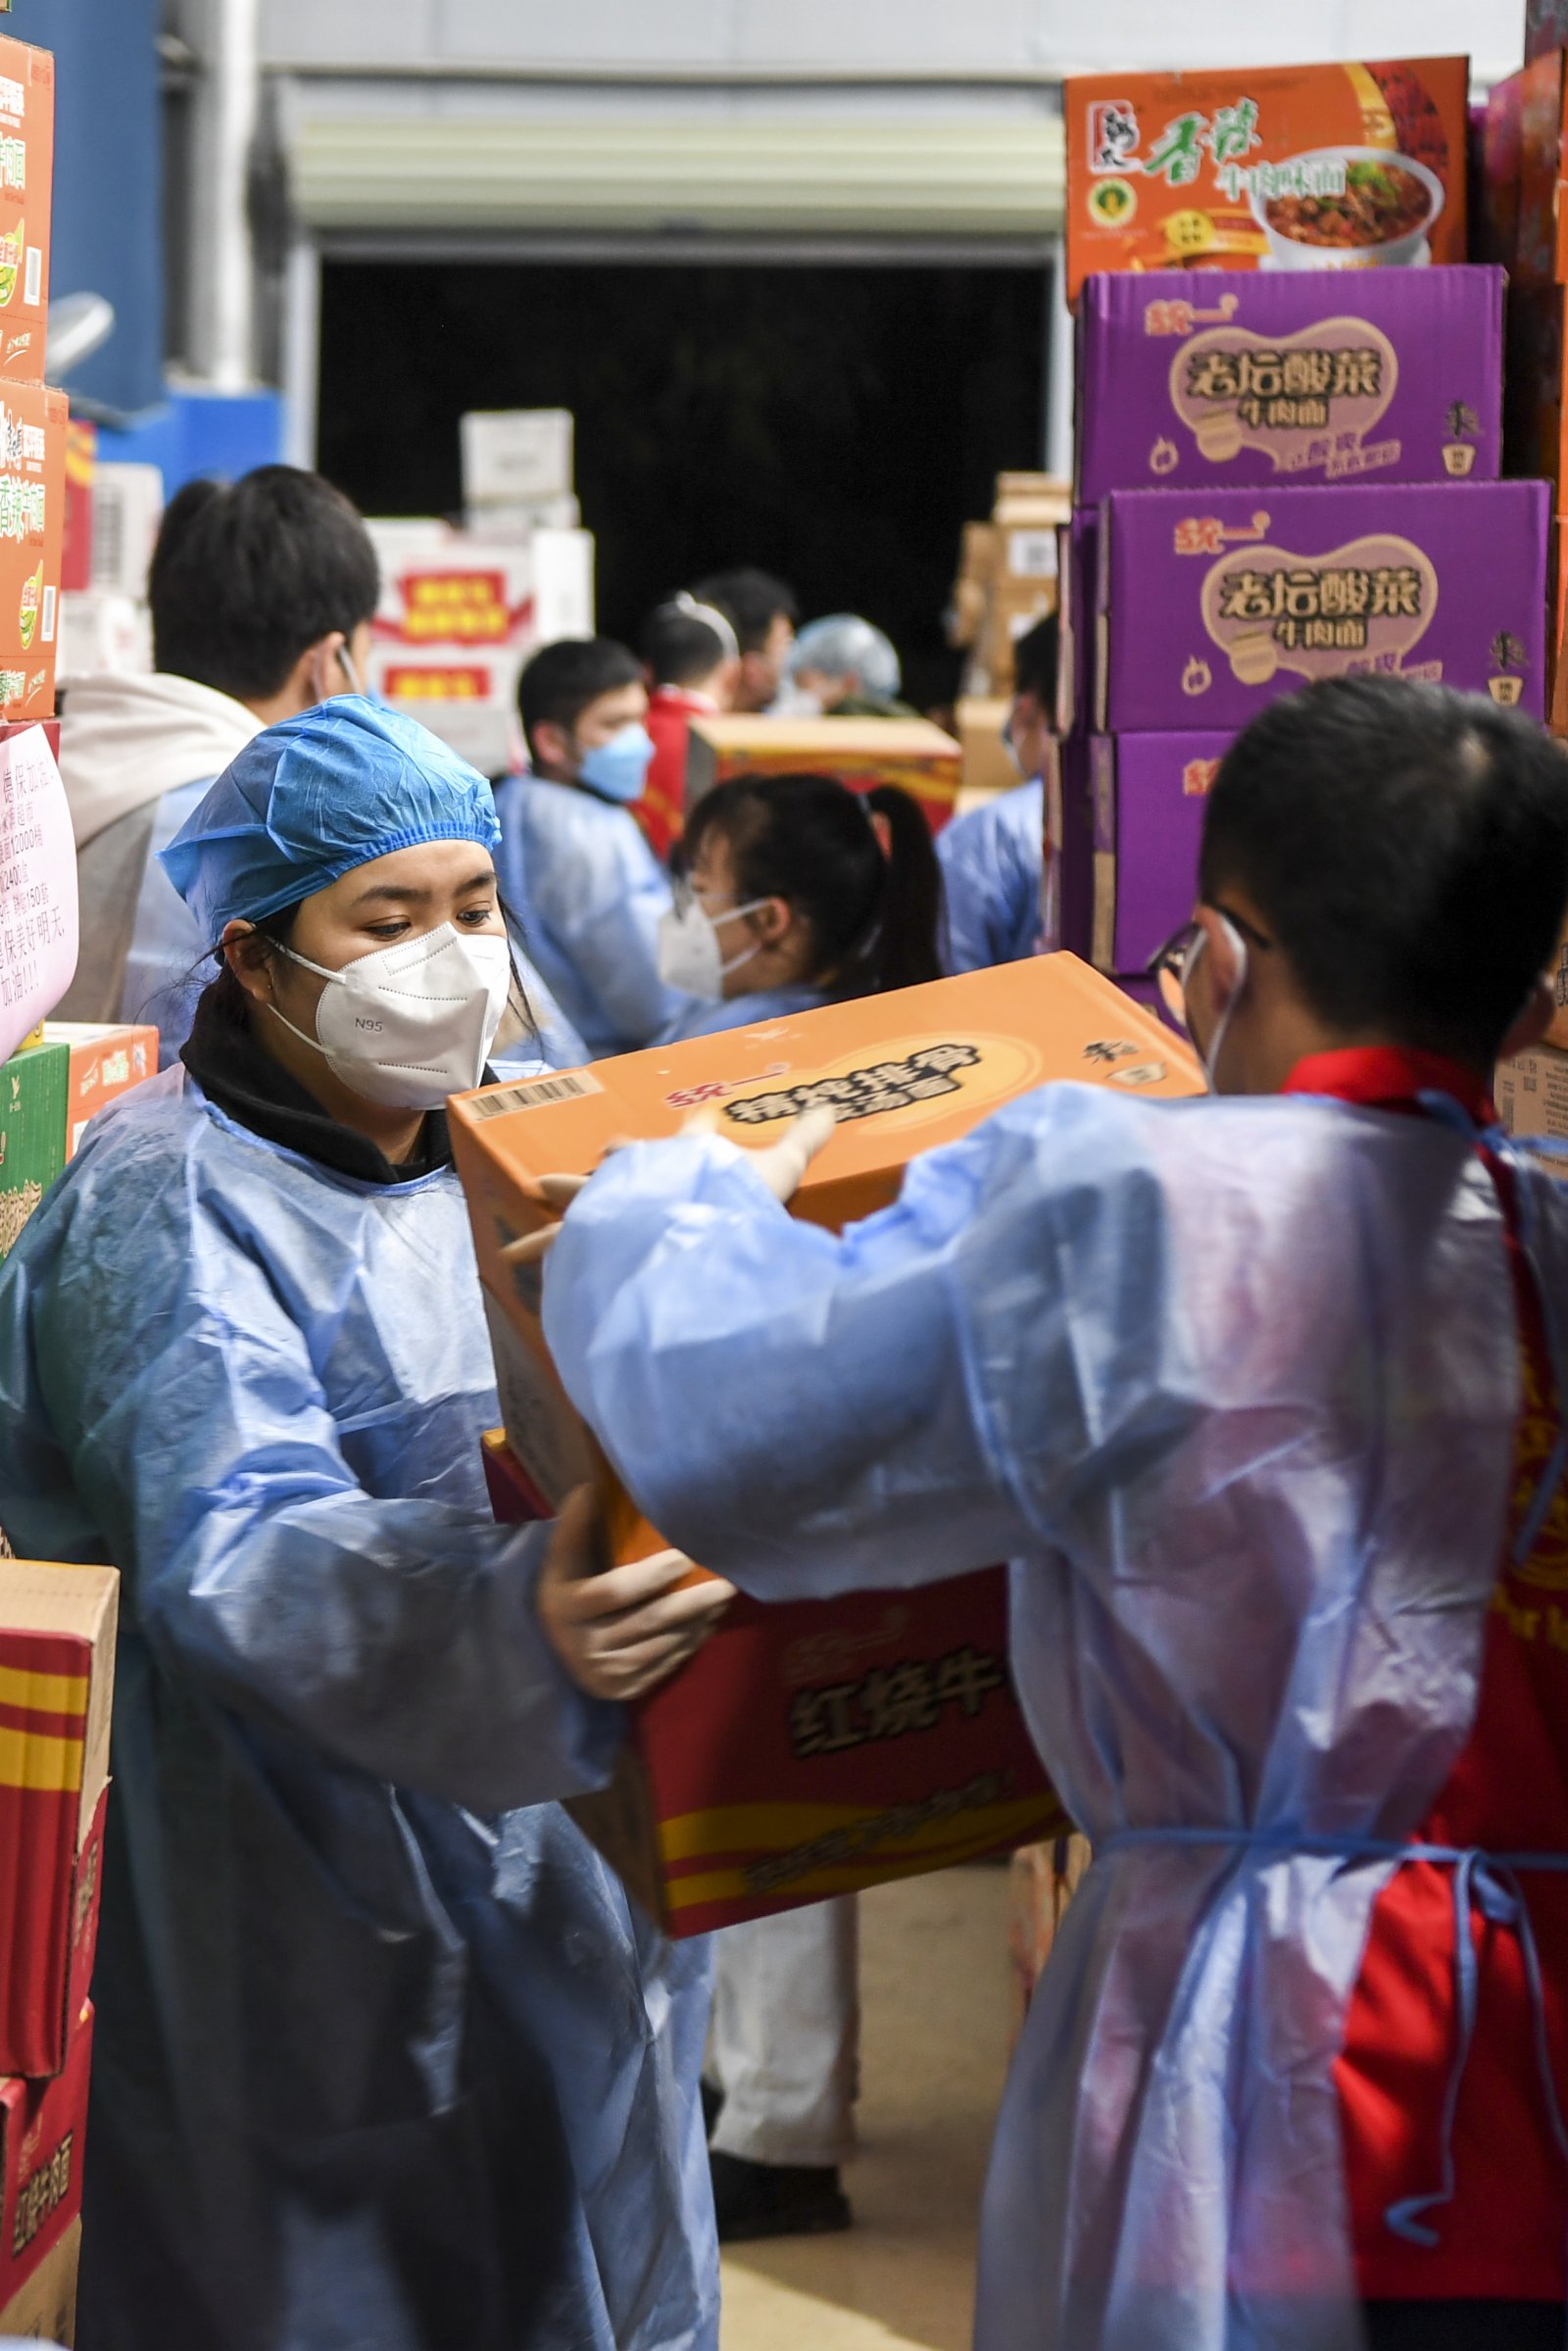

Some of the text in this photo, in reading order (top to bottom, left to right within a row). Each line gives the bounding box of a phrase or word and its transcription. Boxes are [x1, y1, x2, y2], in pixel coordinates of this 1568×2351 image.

[1187, 350, 1381, 400] 老坛酸菜
[1237, 395, 1330, 429] 牛肉面
[1220, 567, 1421, 618] 老坛酸菜
[1273, 616, 1369, 650] 牛肉面
[355, 1017, 383, 1032] N95
